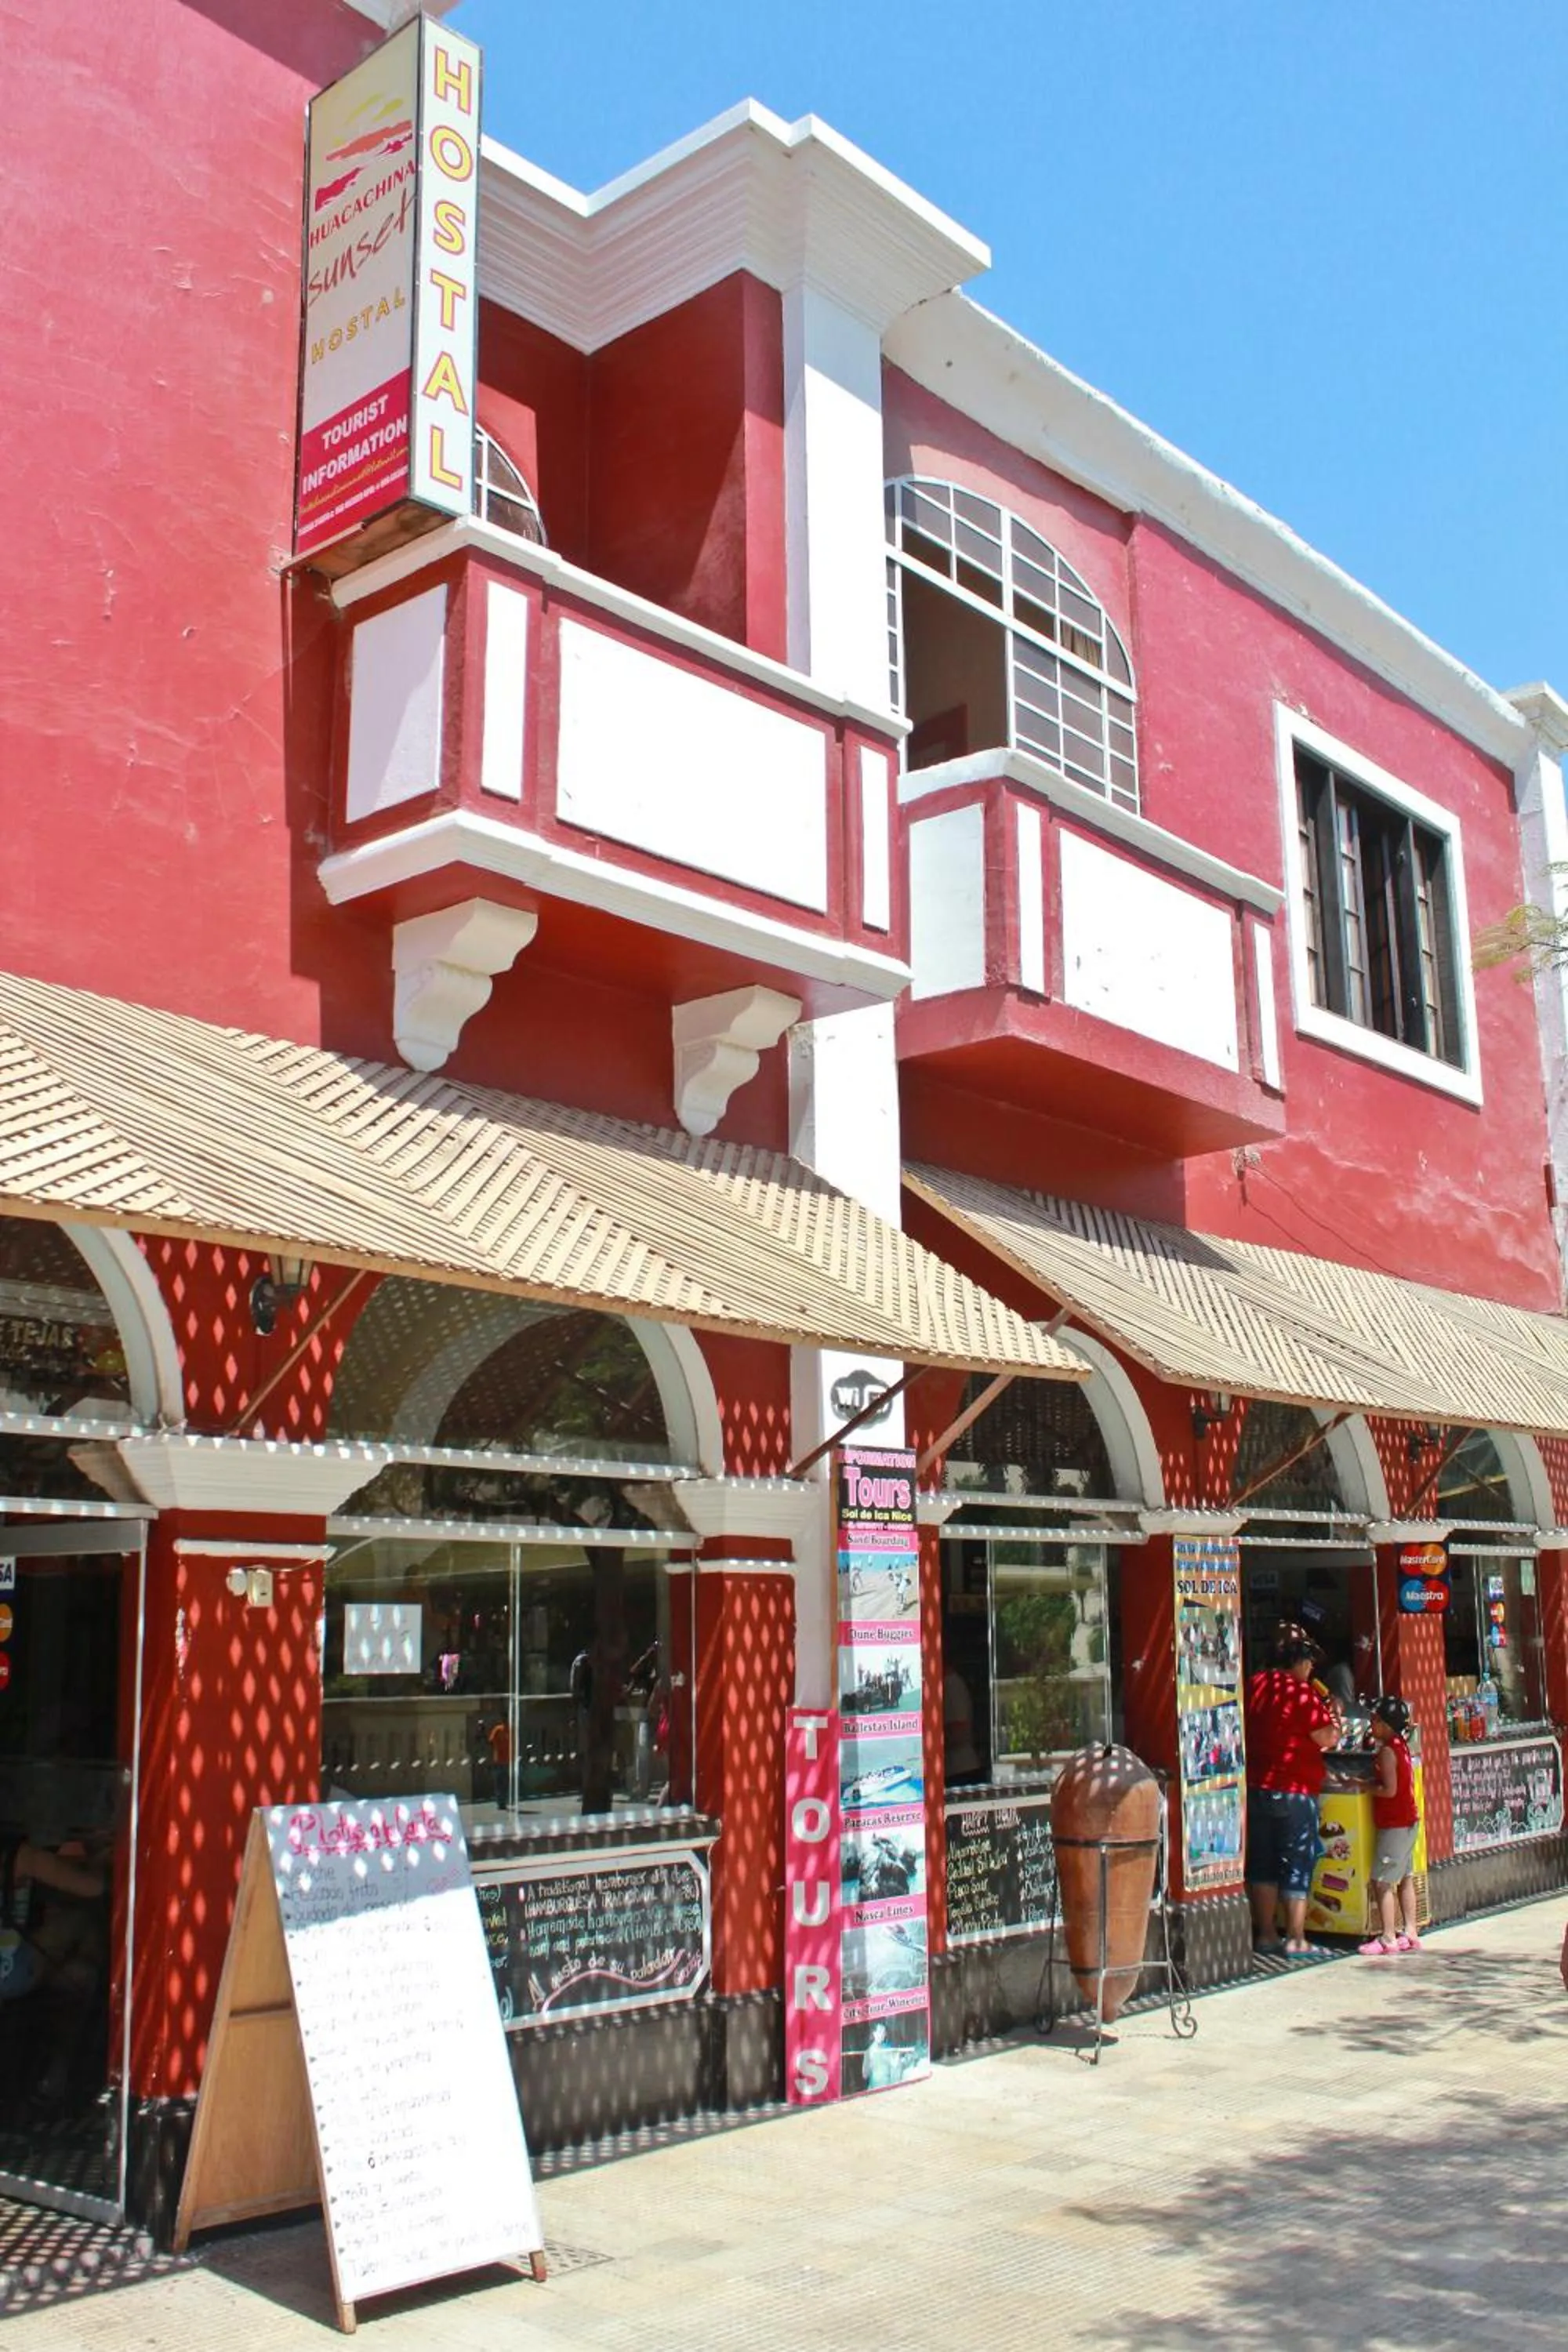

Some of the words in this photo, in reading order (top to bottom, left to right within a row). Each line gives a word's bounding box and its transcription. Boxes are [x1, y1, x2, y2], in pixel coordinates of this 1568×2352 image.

[310, 159, 417, 250] HUACACHINA
[423, 45, 474, 492] HOSTAL
[310, 285, 406, 365] HOSTAL
[322, 394, 389, 452] TOURIST
[302, 414, 408, 495] INFORMATION
[843, 1465, 912, 1509] Tours
[860, 1510, 872, 1519] de
[874, 1510, 890, 1520] Ica
[1177, 1579, 1198, 1594] SOL
[1201, 1580, 1216, 1594] DE
[1218, 1580, 1238, 1594] ICA
[1405, 1589, 1444, 1601] Maestro
[848, 1628, 874, 1639] Dune
[889, 1717, 918, 1730] Island
[792, 1715, 833, 2096] TOURS
